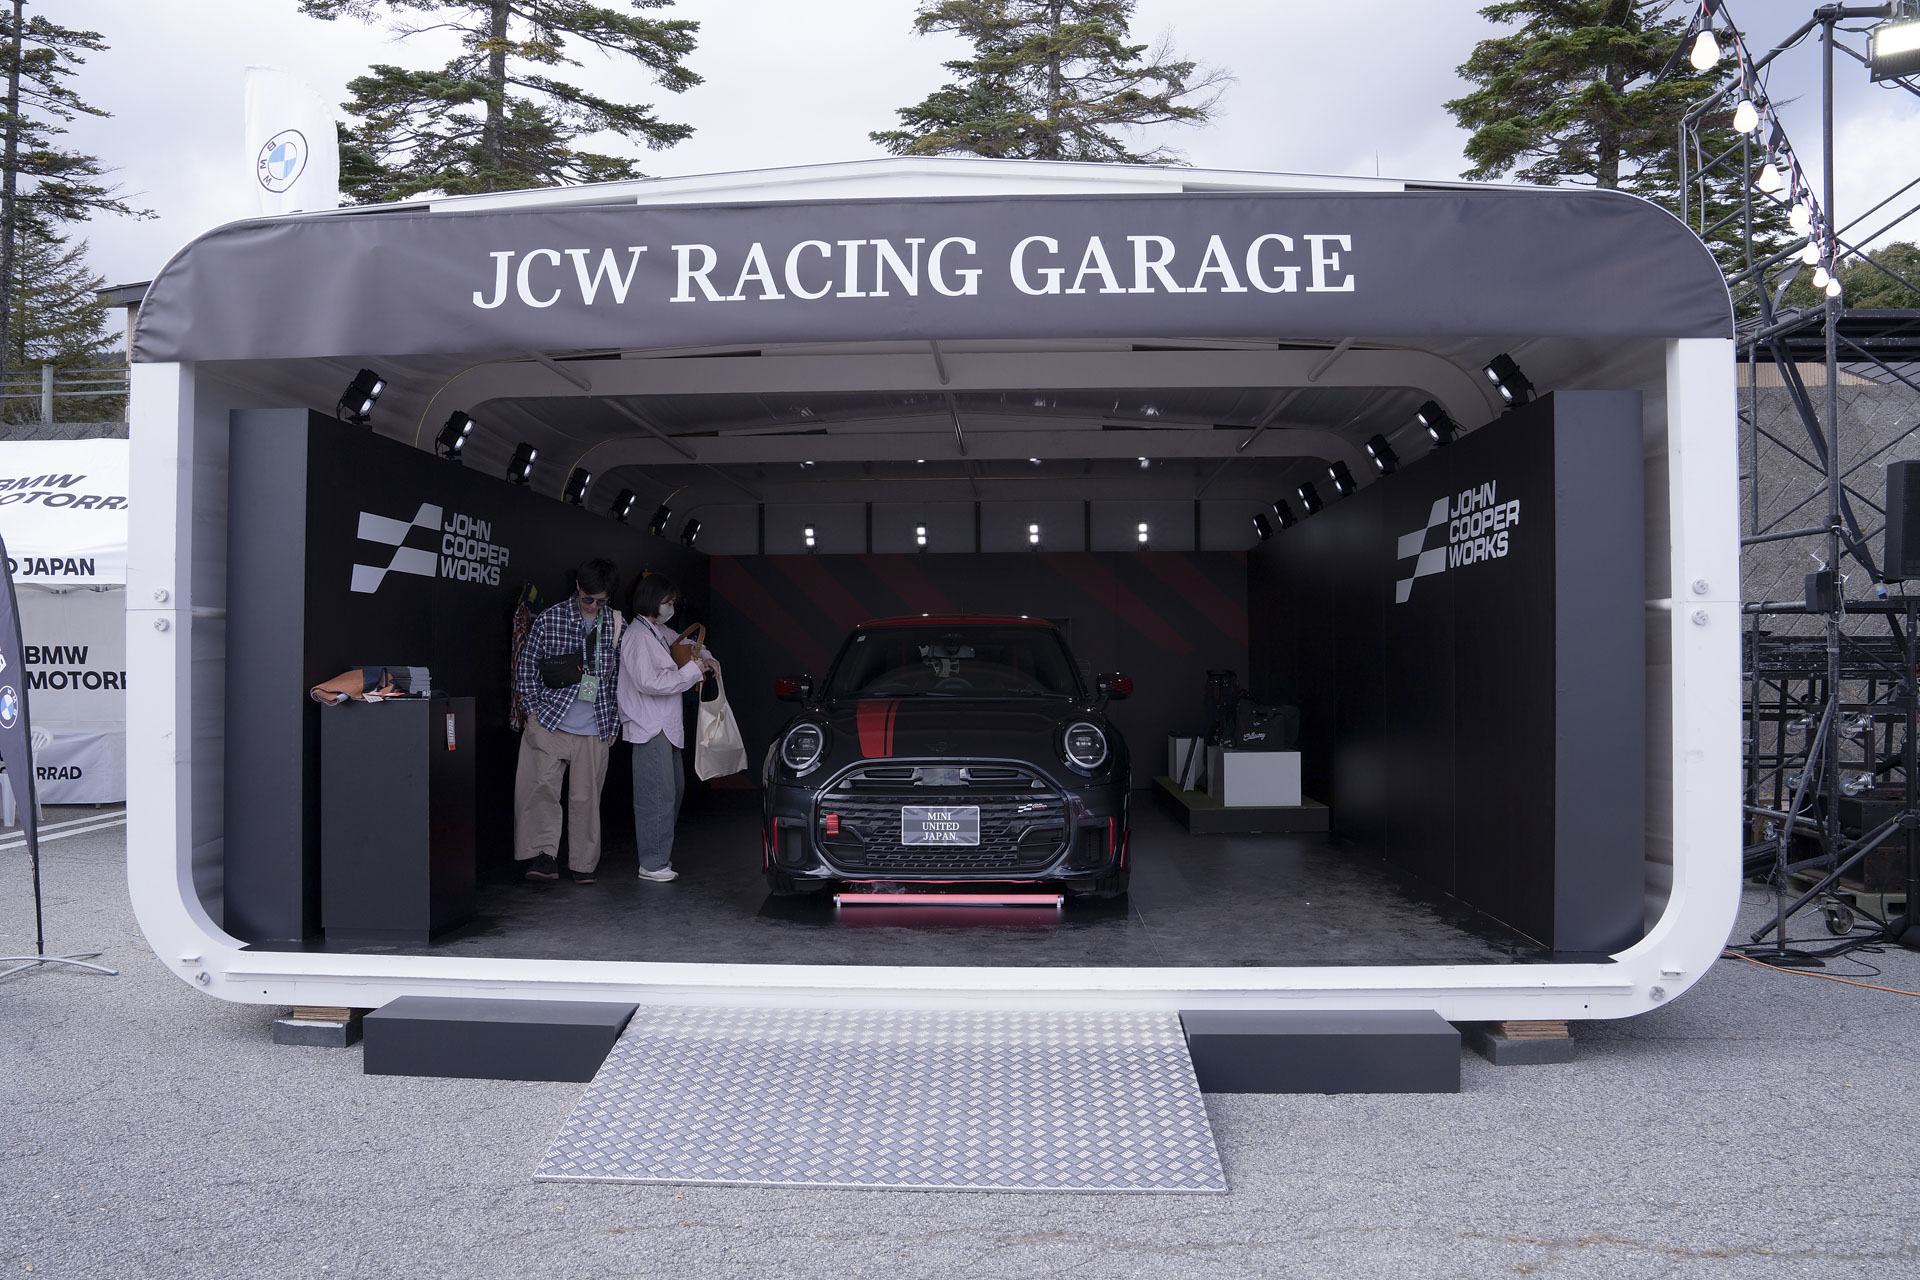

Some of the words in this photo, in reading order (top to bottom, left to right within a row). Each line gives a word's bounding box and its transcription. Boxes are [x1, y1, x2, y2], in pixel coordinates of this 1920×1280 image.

[473, 246, 648, 309] JCW
[670, 237, 982, 302] RACING
[1010, 234, 1355, 295] GARAGE
[0, 474, 87, 491] BMW
[0, 491, 128, 510] OTORR
[1451, 479, 1496, 518] JOHN
[444, 512, 491, 541] JOHN
[1449, 499, 1520, 544] COOPER
[442, 533, 510, 567] COOPER
[1448, 531, 1509, 569] WORKS
[22, 558, 95, 576] JAPAN
[440, 556, 501, 586] WORKS
[25, 646, 89, 665] BMW
[36, 766, 83, 780] RRAD
[927, 812, 952, 820] MINI
[922, 822, 960, 831] UNITED
[923, 832, 959, 841] JAPAN.
